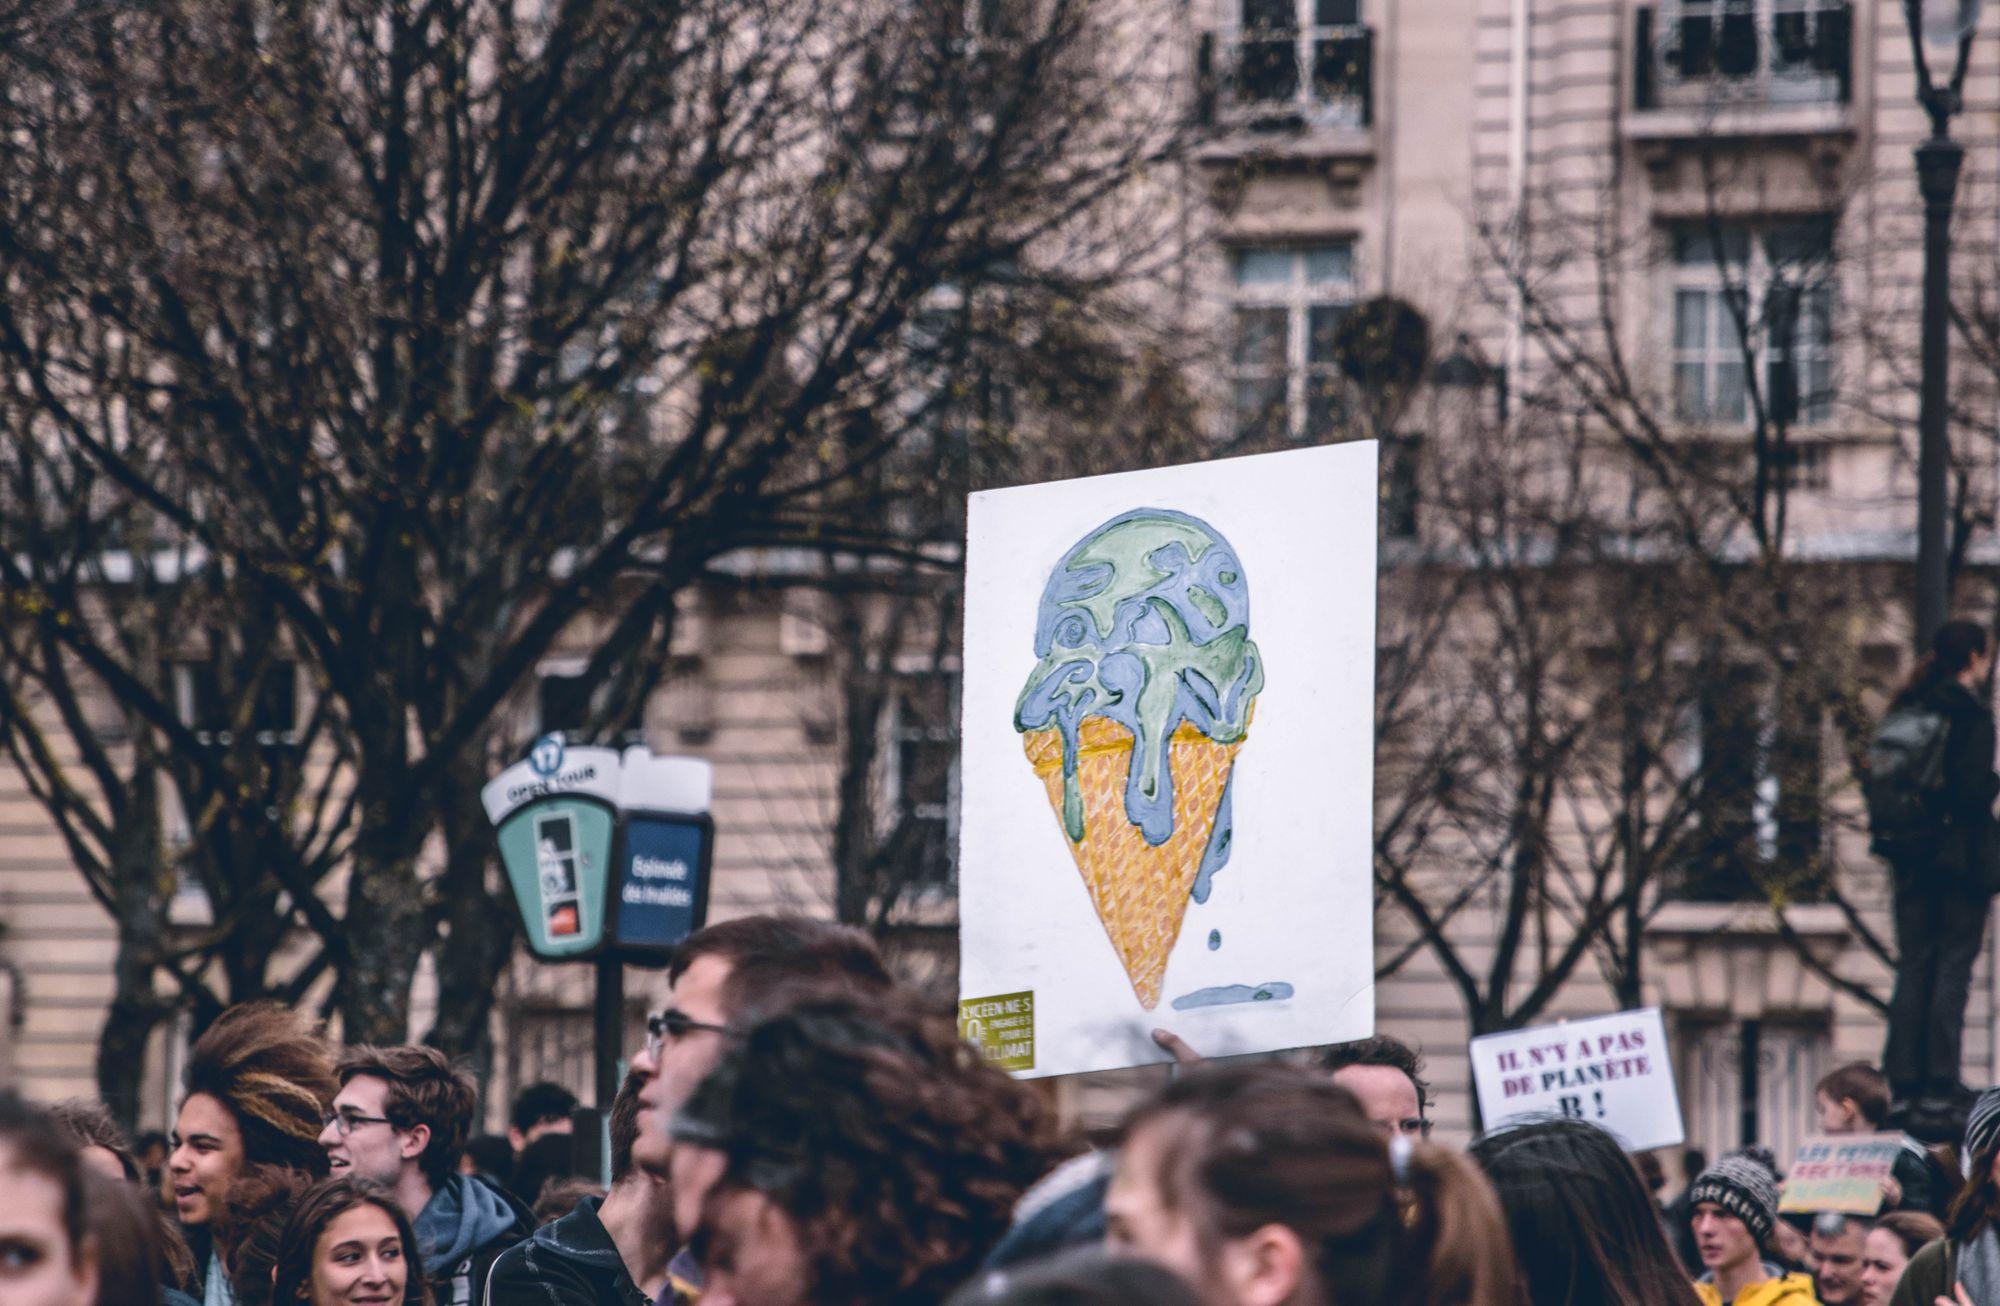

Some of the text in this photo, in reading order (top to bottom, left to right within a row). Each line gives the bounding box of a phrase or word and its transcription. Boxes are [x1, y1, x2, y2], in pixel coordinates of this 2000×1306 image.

[507, 765, 597, 802] OPEN TOUR
[1497, 1030, 1647, 1072] IL N'Y A PAS
[1502, 1055, 1652, 1098] DE PLANÈTE
